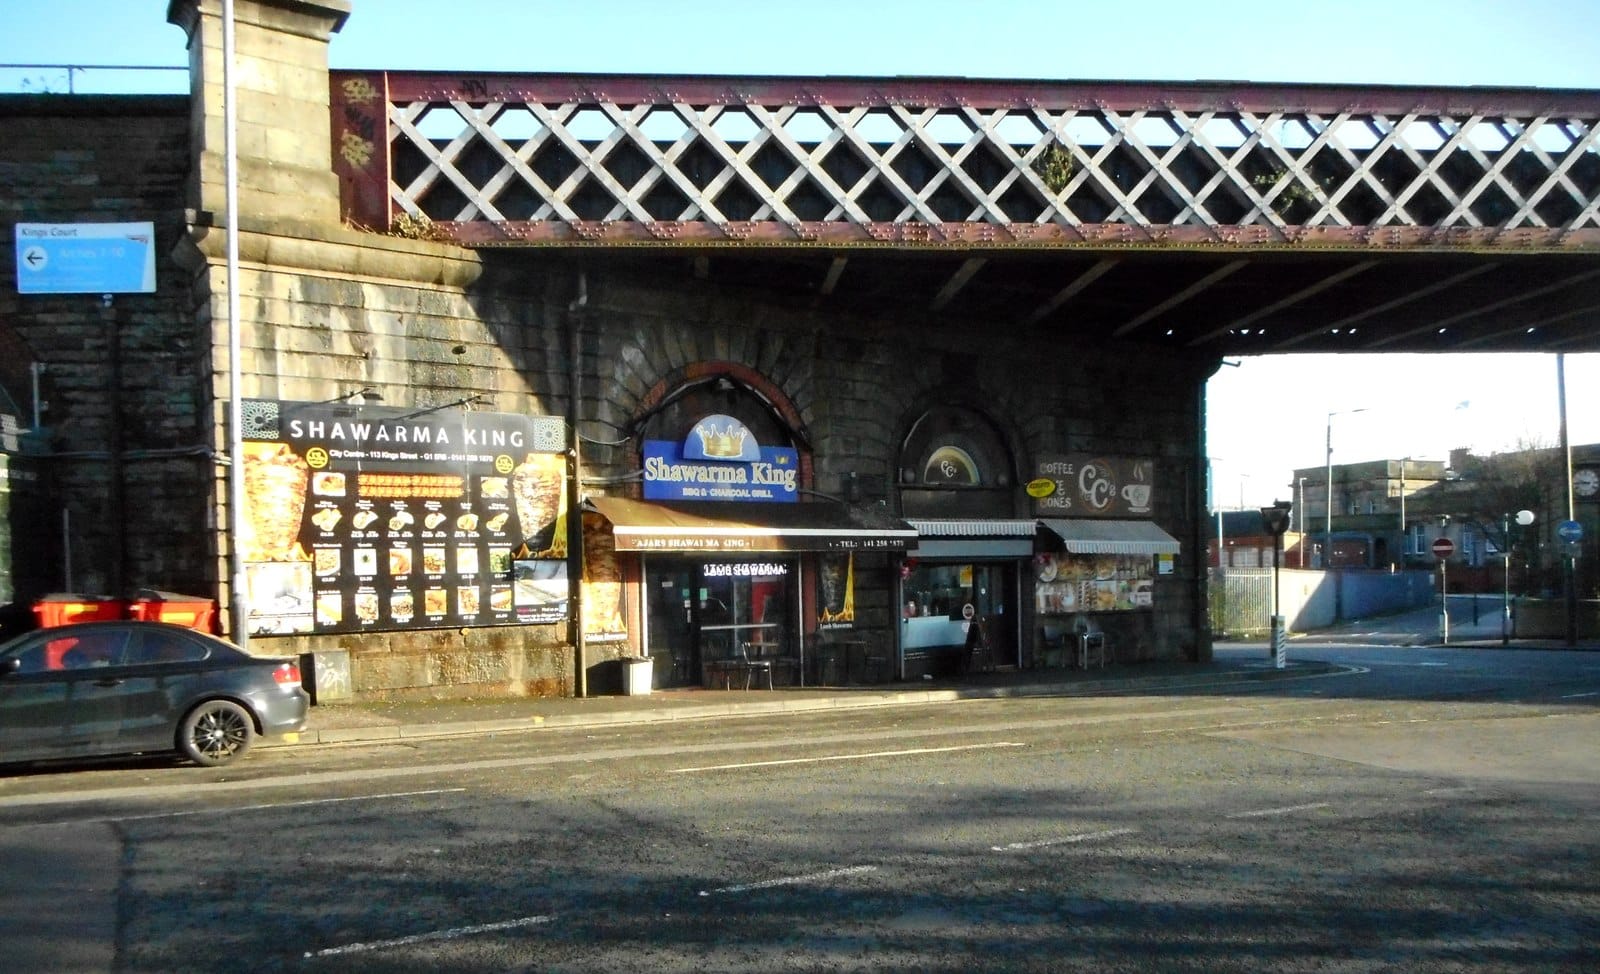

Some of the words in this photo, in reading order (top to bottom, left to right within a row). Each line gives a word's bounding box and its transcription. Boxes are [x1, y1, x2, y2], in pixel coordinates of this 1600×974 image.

[290, 419, 449, 444] SHAWARMA
[463, 429, 524, 447] KING
[645, 456, 747, 484] Shawarma
[751, 462, 796, 492] King
[1040, 462, 1075, 475] COFFEE
